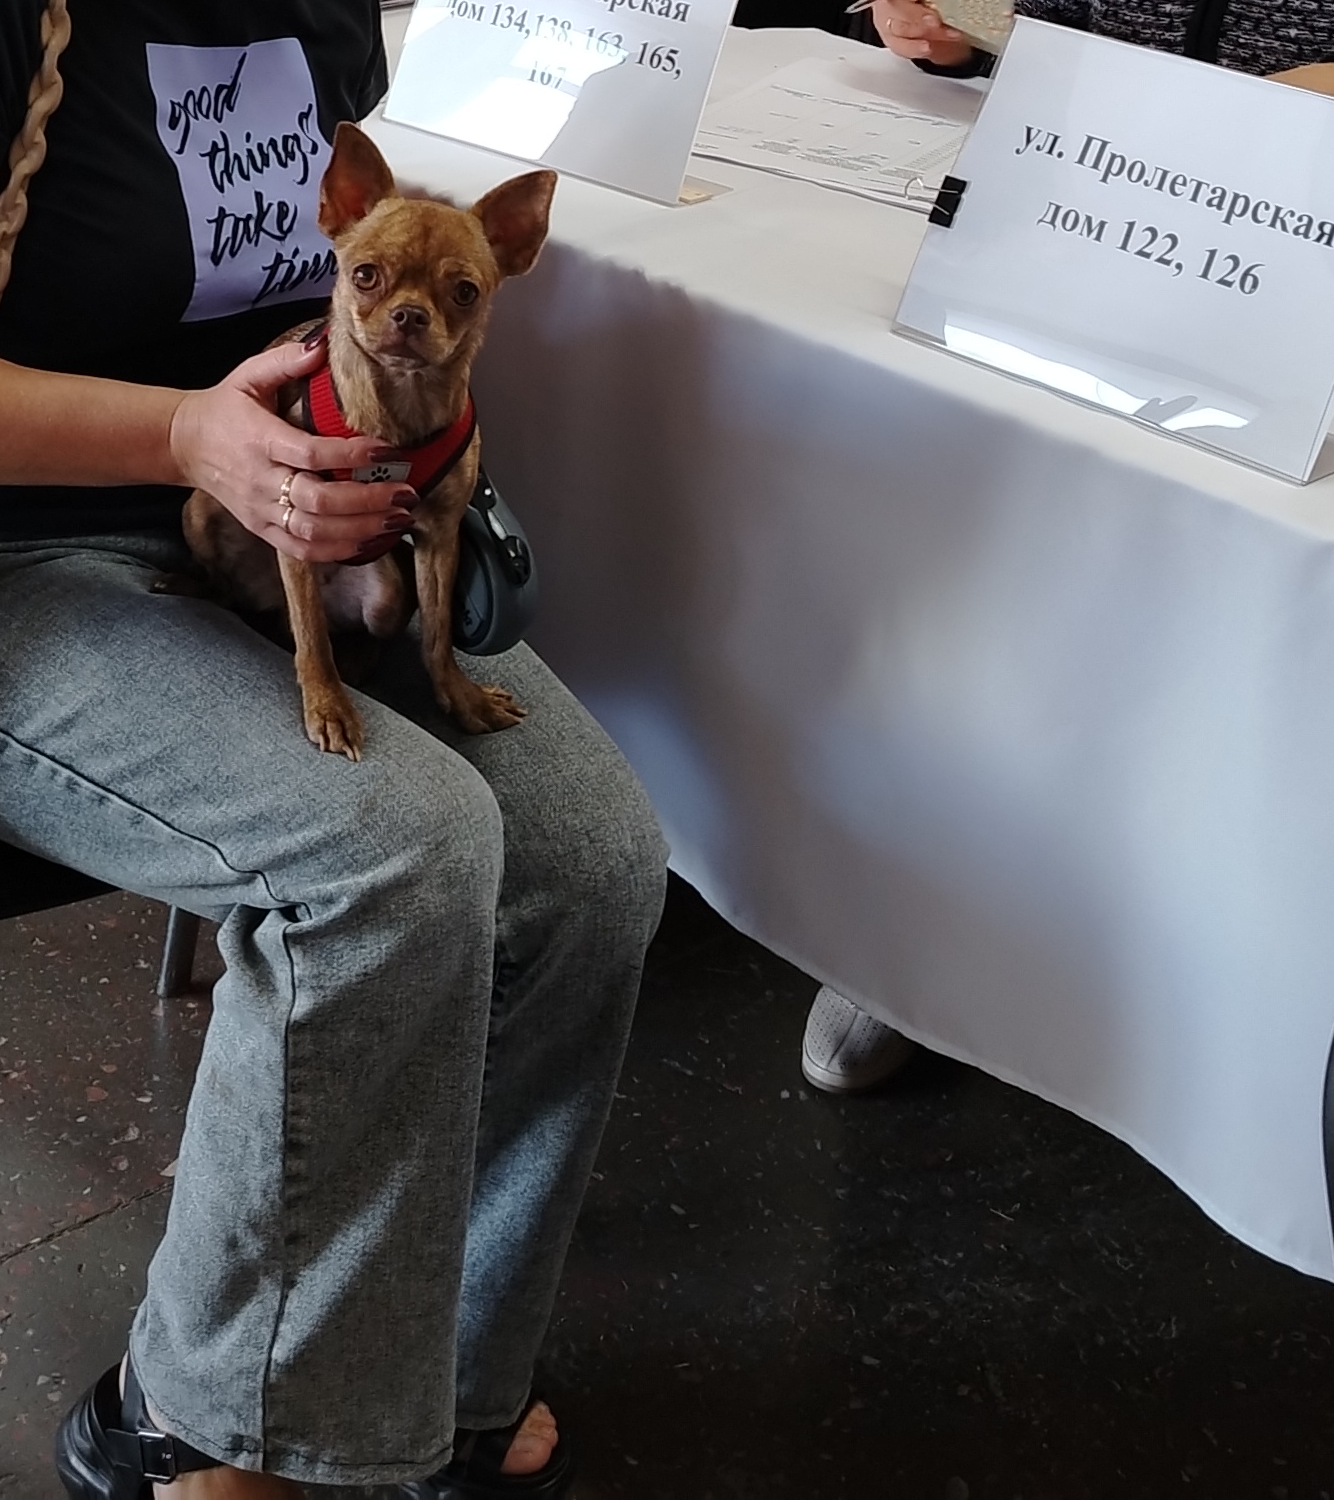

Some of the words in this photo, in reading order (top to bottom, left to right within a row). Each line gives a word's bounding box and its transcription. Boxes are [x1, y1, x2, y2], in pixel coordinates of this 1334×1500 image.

[634, 40, 682, 82] 165,
[168, 51, 248, 155] good
[1015, 122, 1065, 159] ул.
[199, 103, 319, 194] things
[206, 190, 298, 267] take
[1035, 198, 1108, 244] дом
[1115, 219, 1185, 278] 122,
[1196, 247, 1266, 297] 126
[252, 246, 339, 307] tim
